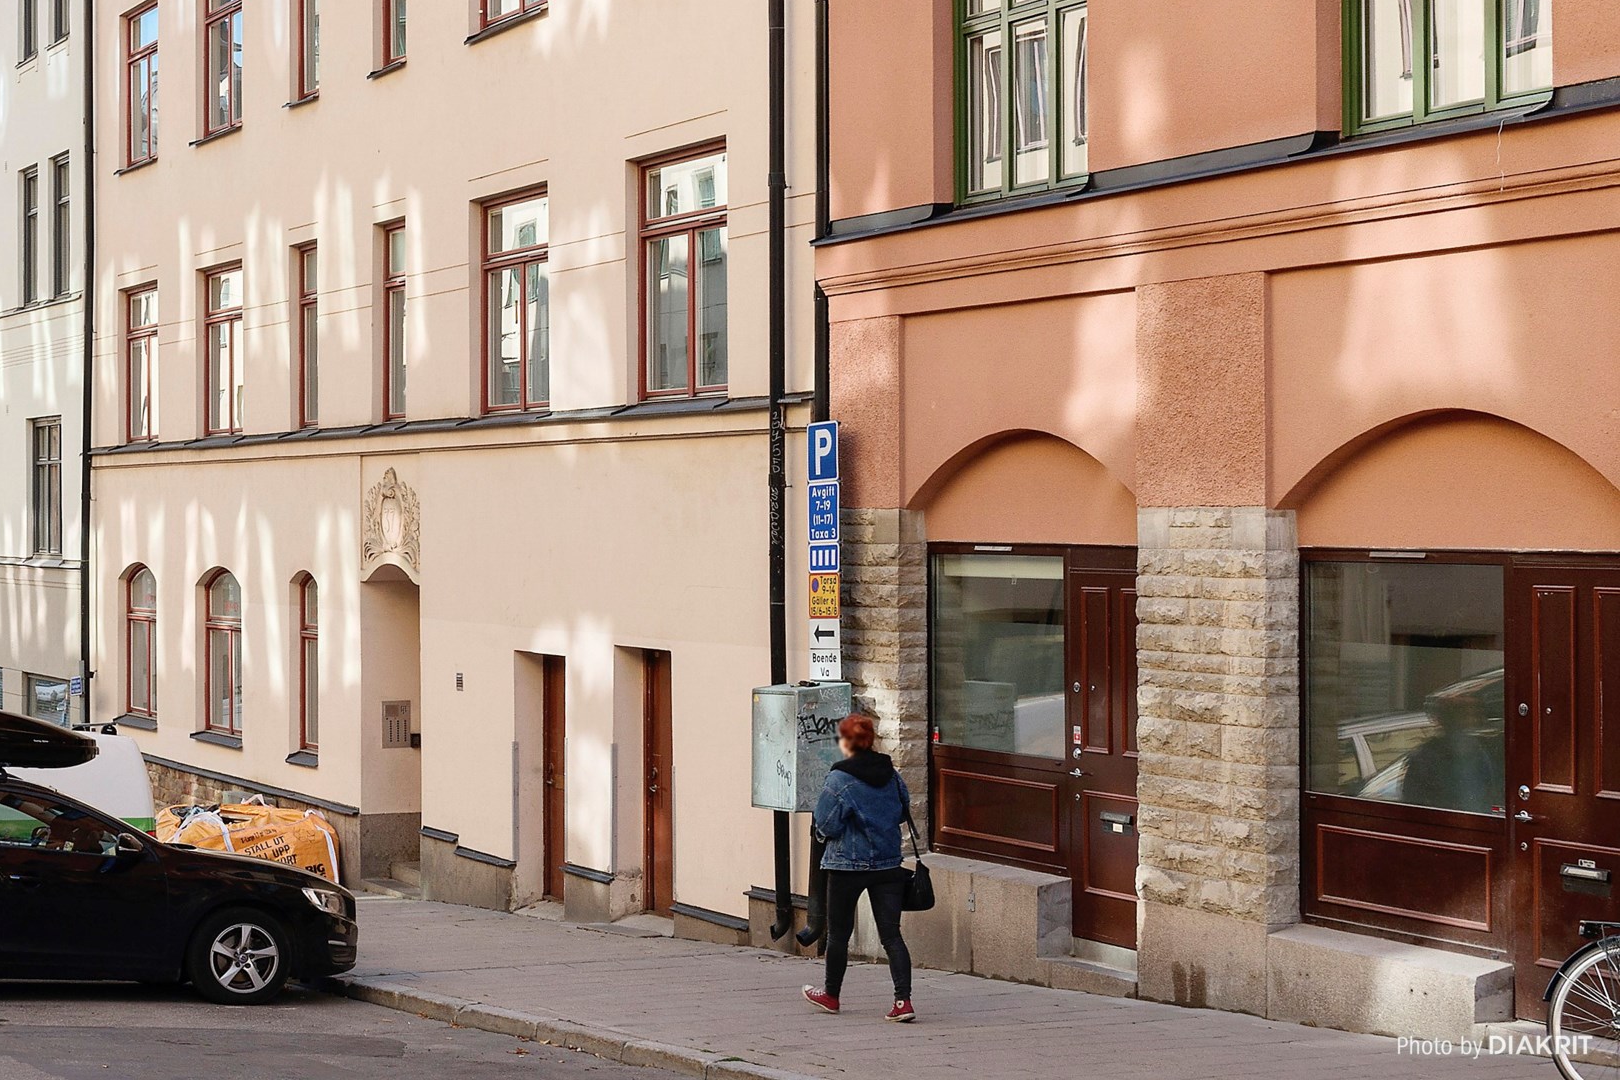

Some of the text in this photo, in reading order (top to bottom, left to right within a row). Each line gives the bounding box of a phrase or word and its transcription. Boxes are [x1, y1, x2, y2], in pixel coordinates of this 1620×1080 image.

[815, 428, 833, 476] P
[811, 486, 835, 499] Avgift
[815, 500, 831, 511] 7-19
[813, 513, 834, 526] (11-17)
[810, 527, 836, 539] Taxa 3
[819, 575, 837, 585] Torsd
[821, 585, 836, 595] 9-14
[811, 595, 837, 608] Gäller ej
[812, 652, 837, 664] Boende
[820, 667, 830, 677] Va
[272, 835, 285, 846] UT
[271, 844, 290, 858] UPP
[278, 853, 297, 865] ORT
